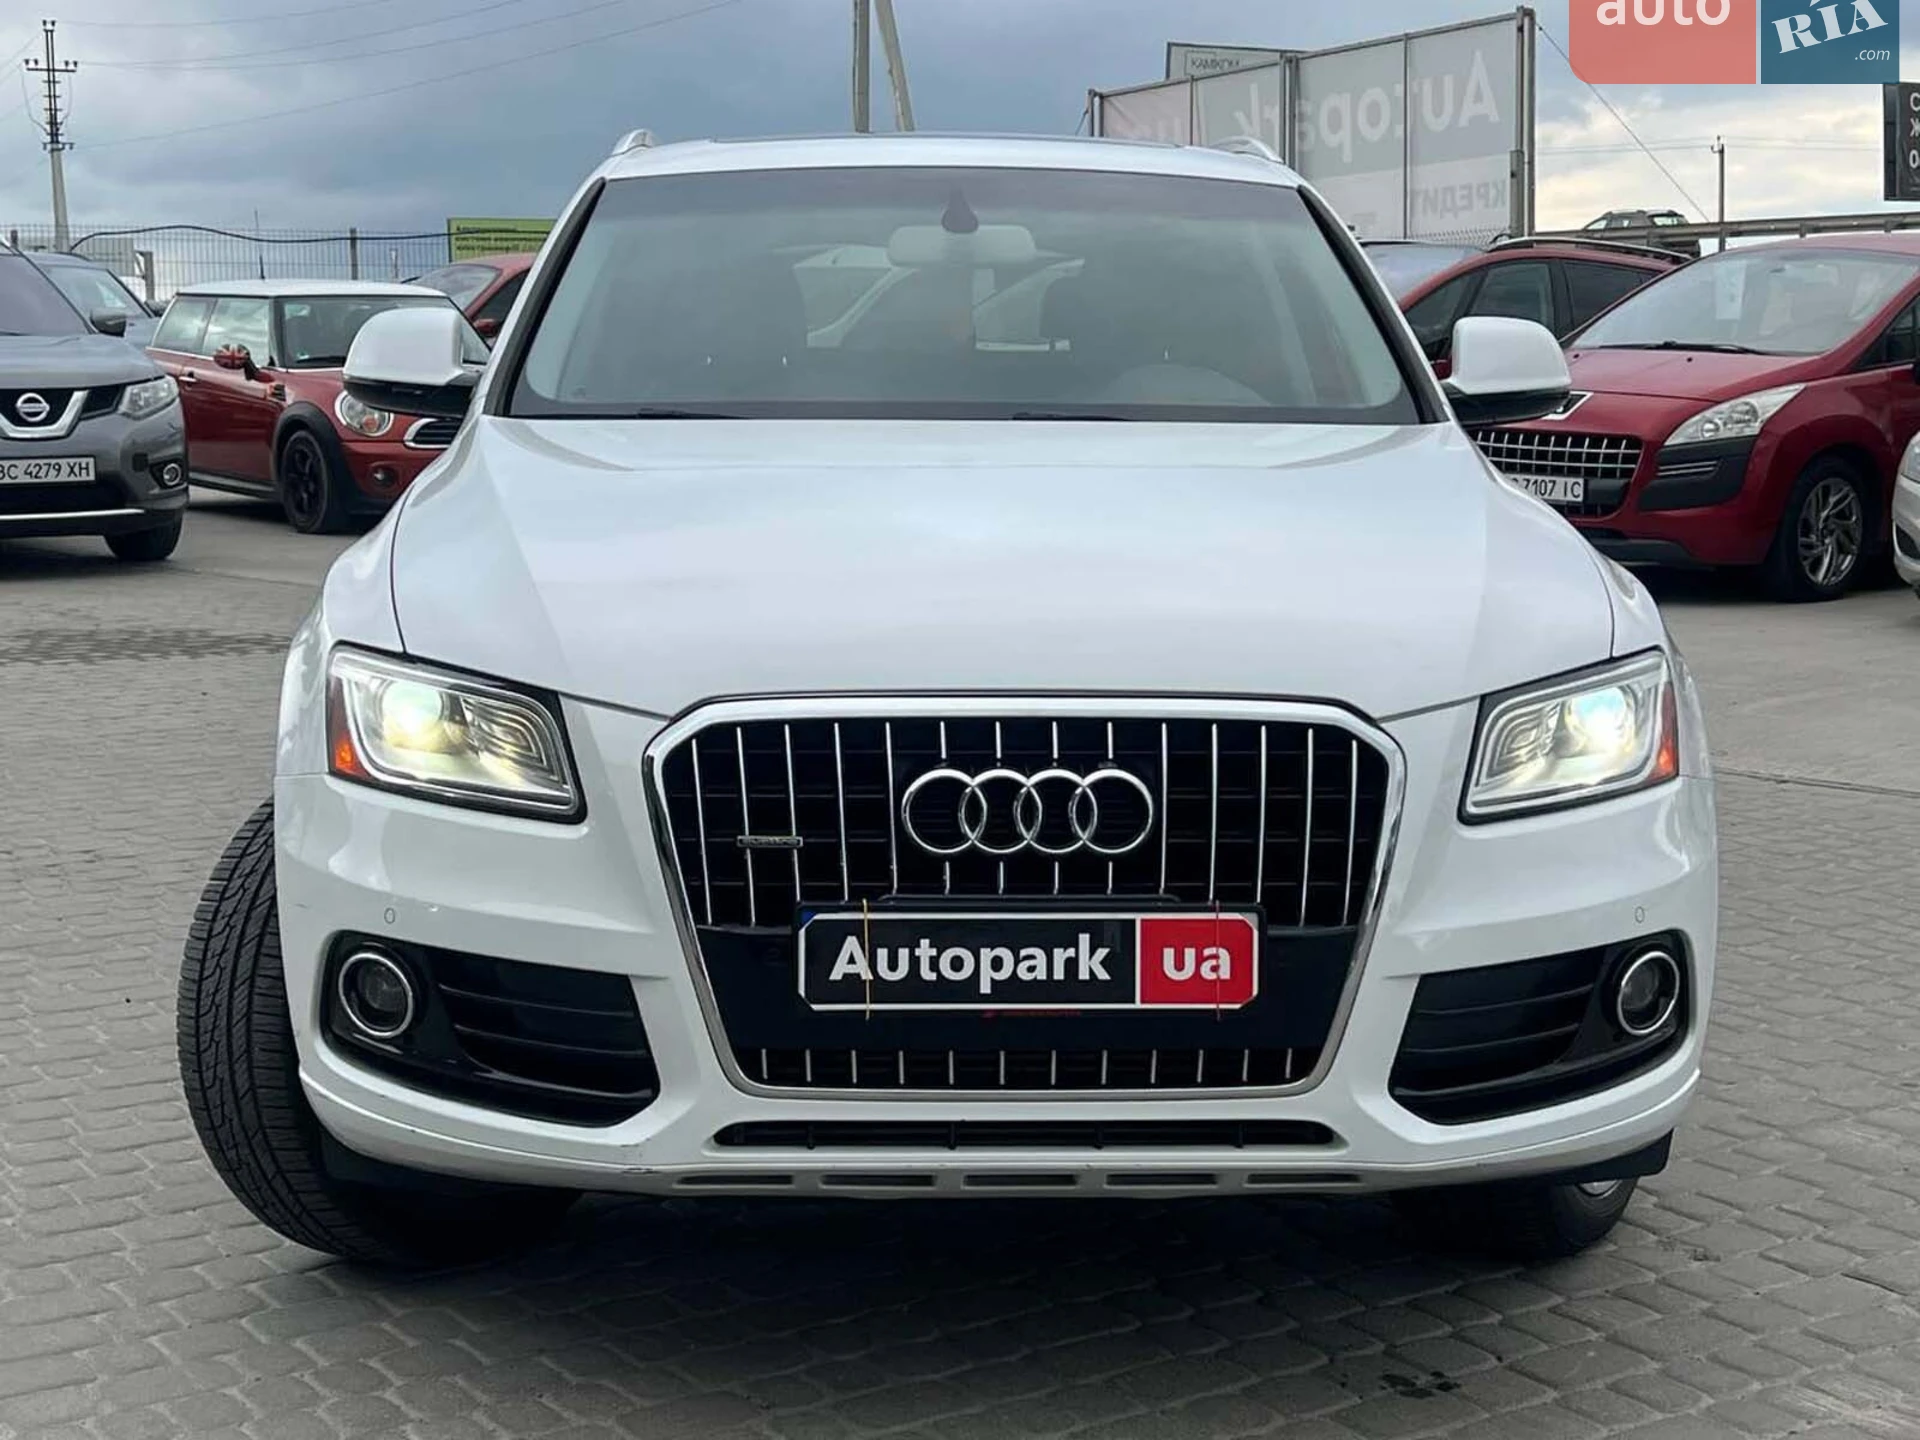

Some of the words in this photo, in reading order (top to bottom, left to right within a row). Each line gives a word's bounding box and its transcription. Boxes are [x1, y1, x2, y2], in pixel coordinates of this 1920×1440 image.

[24, 462, 62, 479] 4279
[67, 462, 90, 478] XH
[1564, 481, 1581, 498] IC
[829, 933, 1111, 994] Autopark
[1162, 946, 1231, 980] ua
